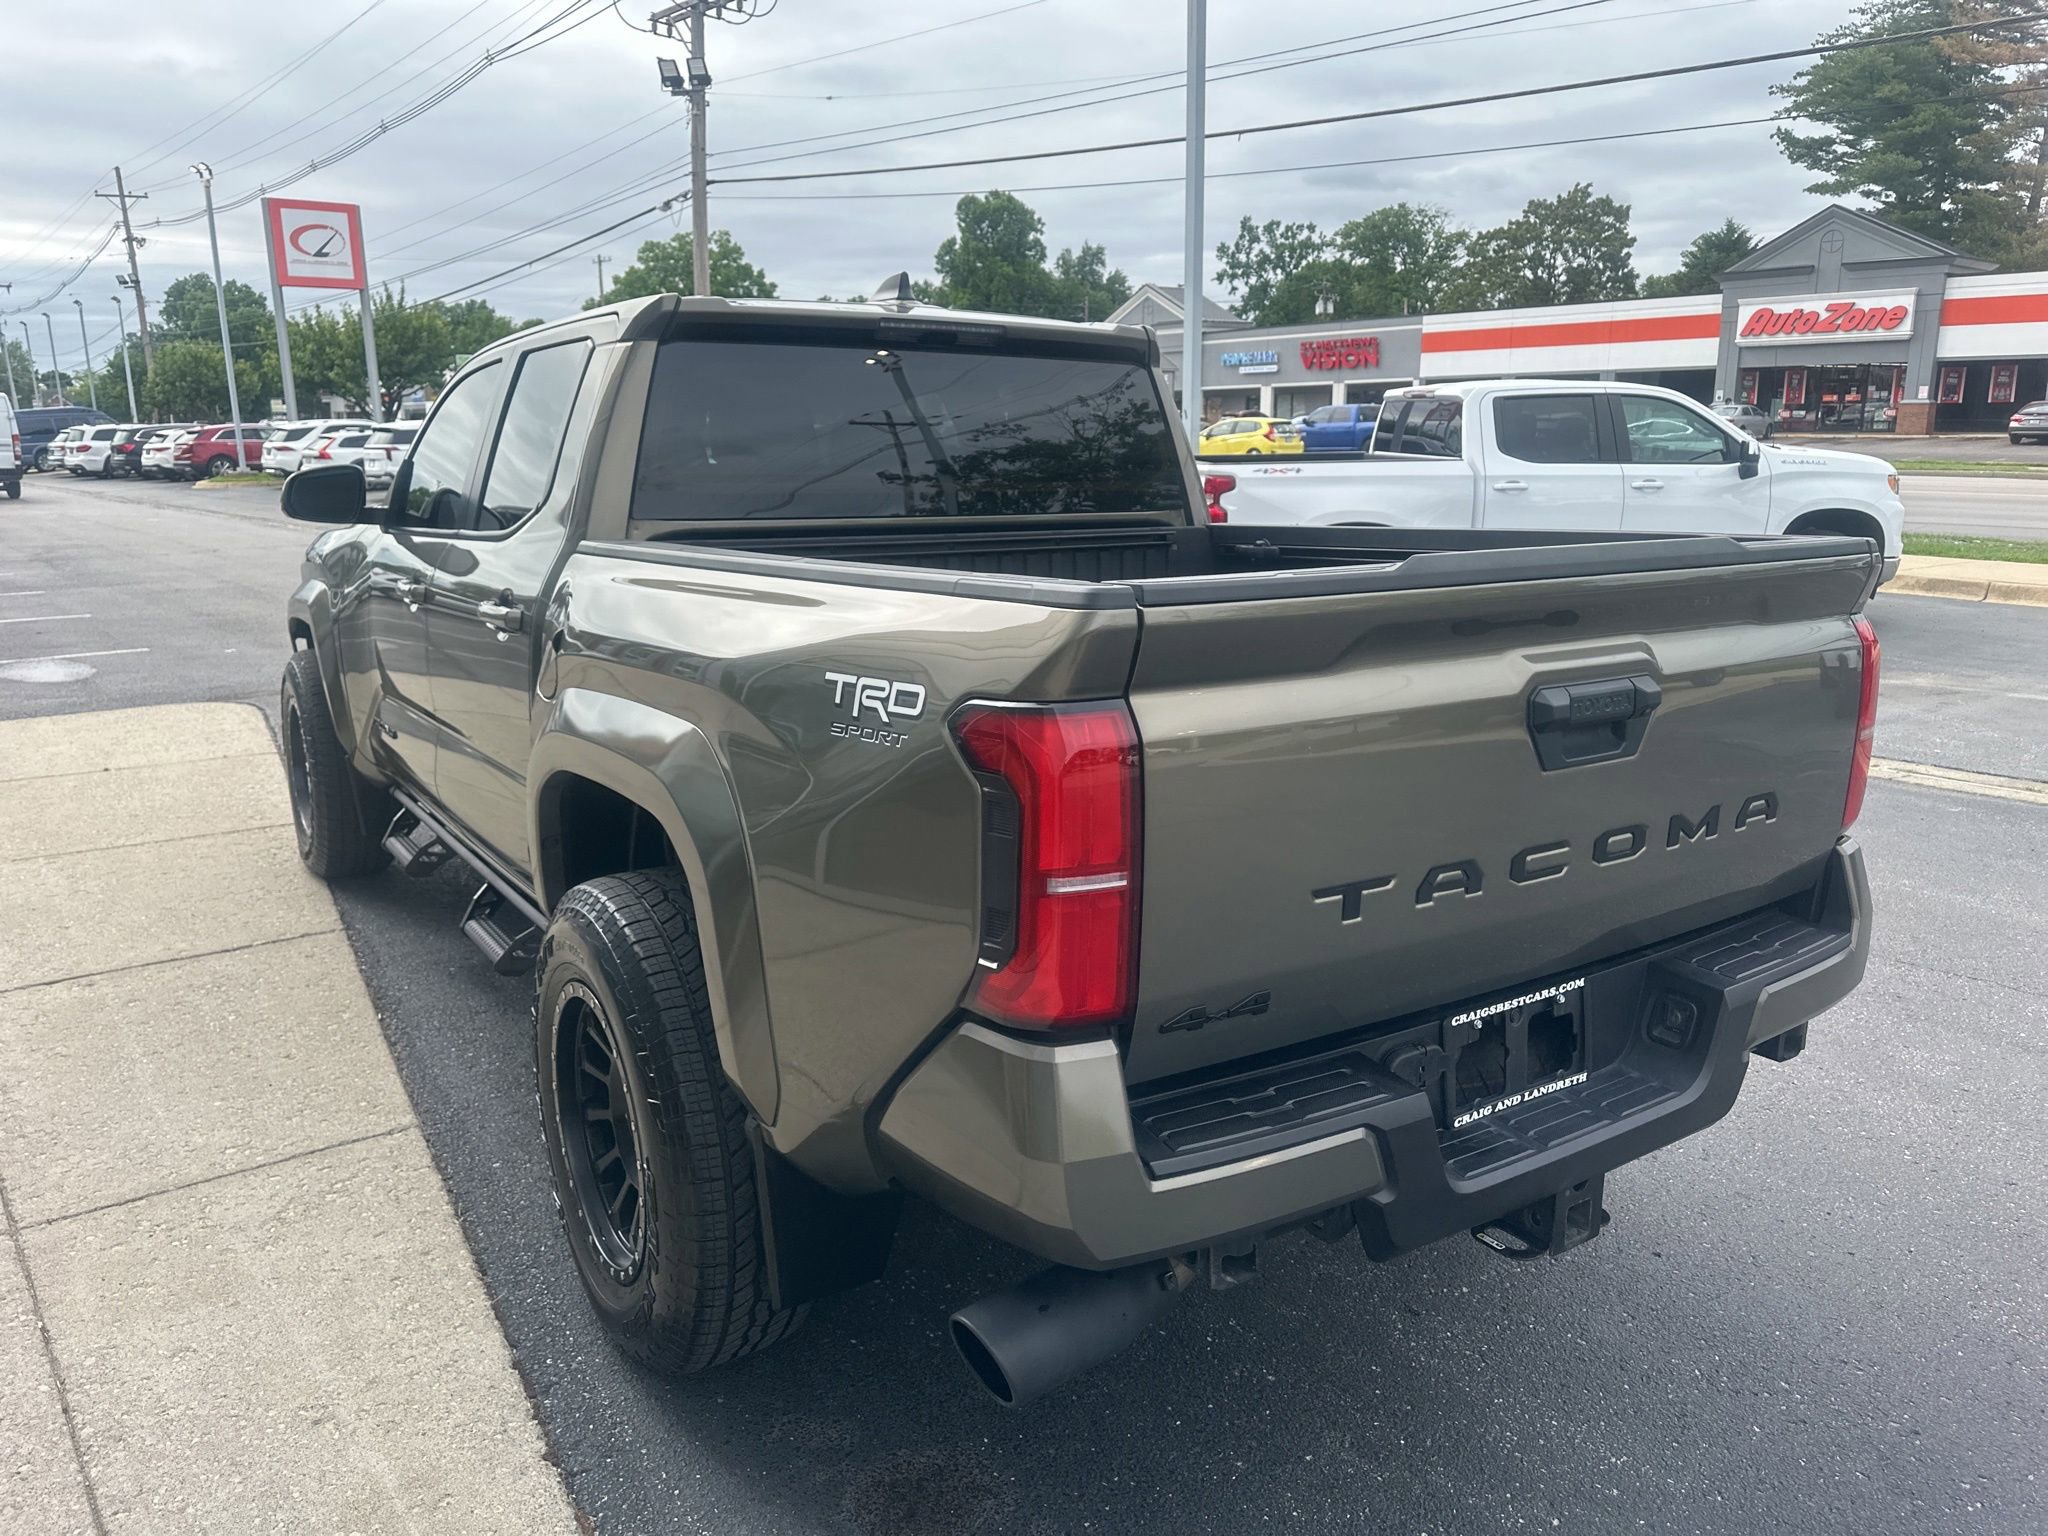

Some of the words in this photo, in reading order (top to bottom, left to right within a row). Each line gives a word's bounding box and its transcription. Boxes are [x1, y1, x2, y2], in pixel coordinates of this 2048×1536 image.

[1740, 302, 1908, 337] AutoZone
[1301, 347, 1380, 369] VISION
[825, 671, 926, 723] TRD
[831, 722, 908, 748] SPORT
[1312, 791, 1779, 925] TACOMA
[1451, 977, 1585, 1026] CRAIGSBESTCARS.COM
[1454, 1105, 1493, 1128] CRAIG
[1494, 1095, 1521, 1112] AND
[1523, 1072, 1588, 1102] LANDRETH
